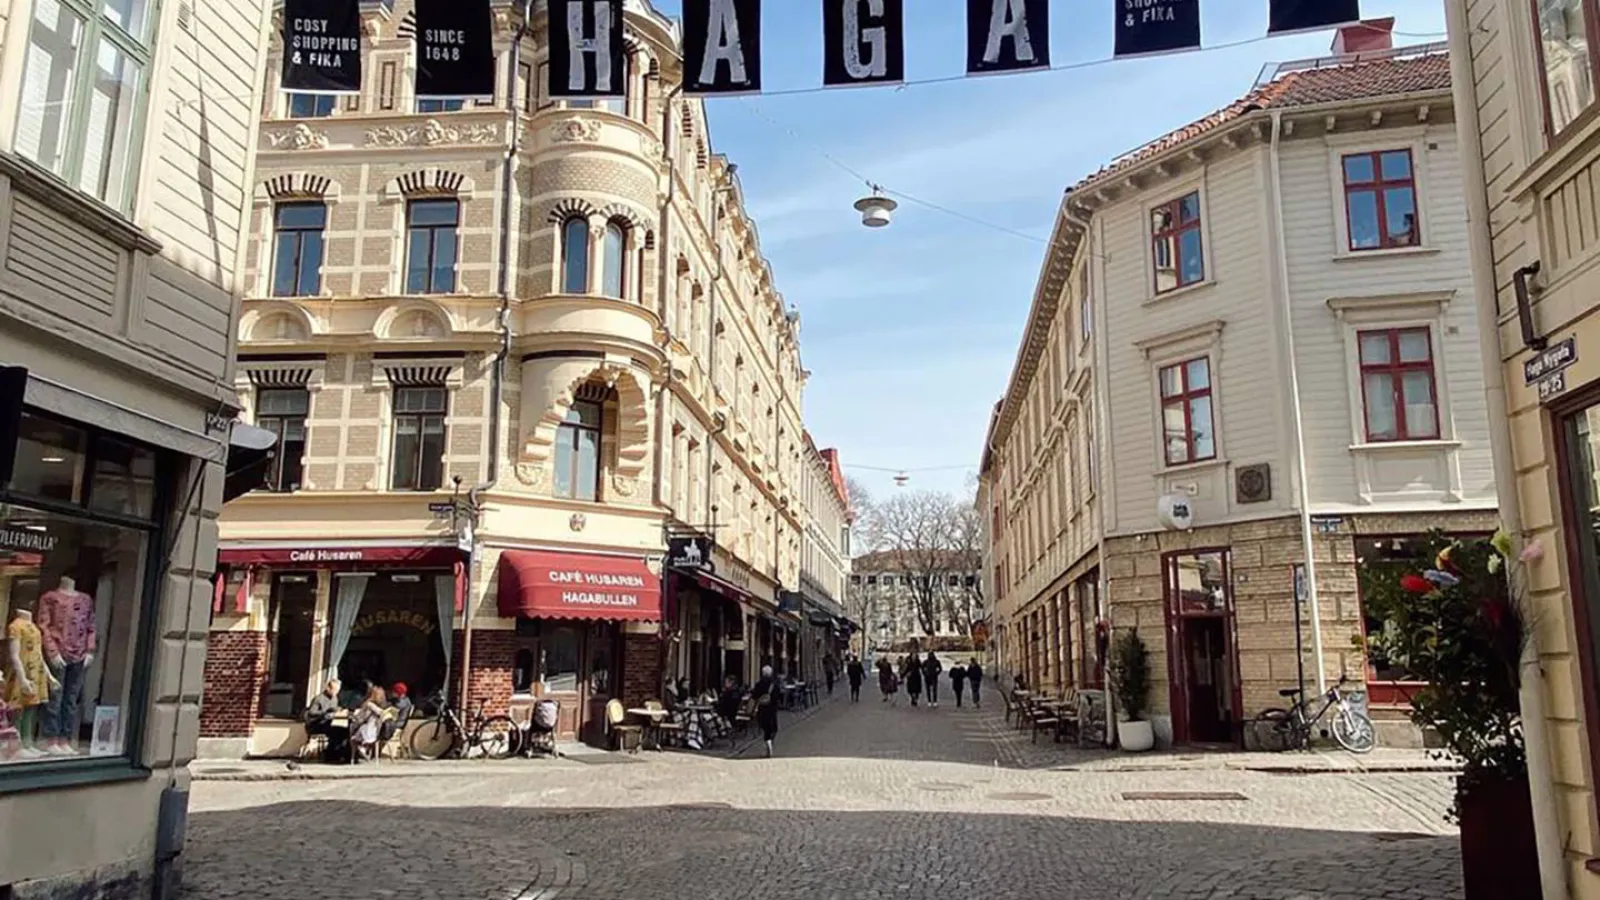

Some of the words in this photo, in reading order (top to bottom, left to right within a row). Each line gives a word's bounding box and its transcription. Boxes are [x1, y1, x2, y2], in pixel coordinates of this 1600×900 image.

[1125, 14, 1135, 26] &
[1142, 7, 1175, 22] FIKA
[294, 18, 328, 33] COSY
[292, 36, 358, 50] SHOPPING
[425, 29, 465, 44] SINCE
[291, 52, 302, 65] &
[309, 53, 342, 68] FIKA
[425, 46, 461, 61] 1648
[0, 529, 55, 551] ILLERVALLA
[290, 550, 316, 562] Café
[317, 551, 363, 561] Husaren
[549, 570, 584, 586] CAFÉ
[586, 573, 644, 587] HUSAREN
[562, 592, 637, 605] HAGABULLEN
